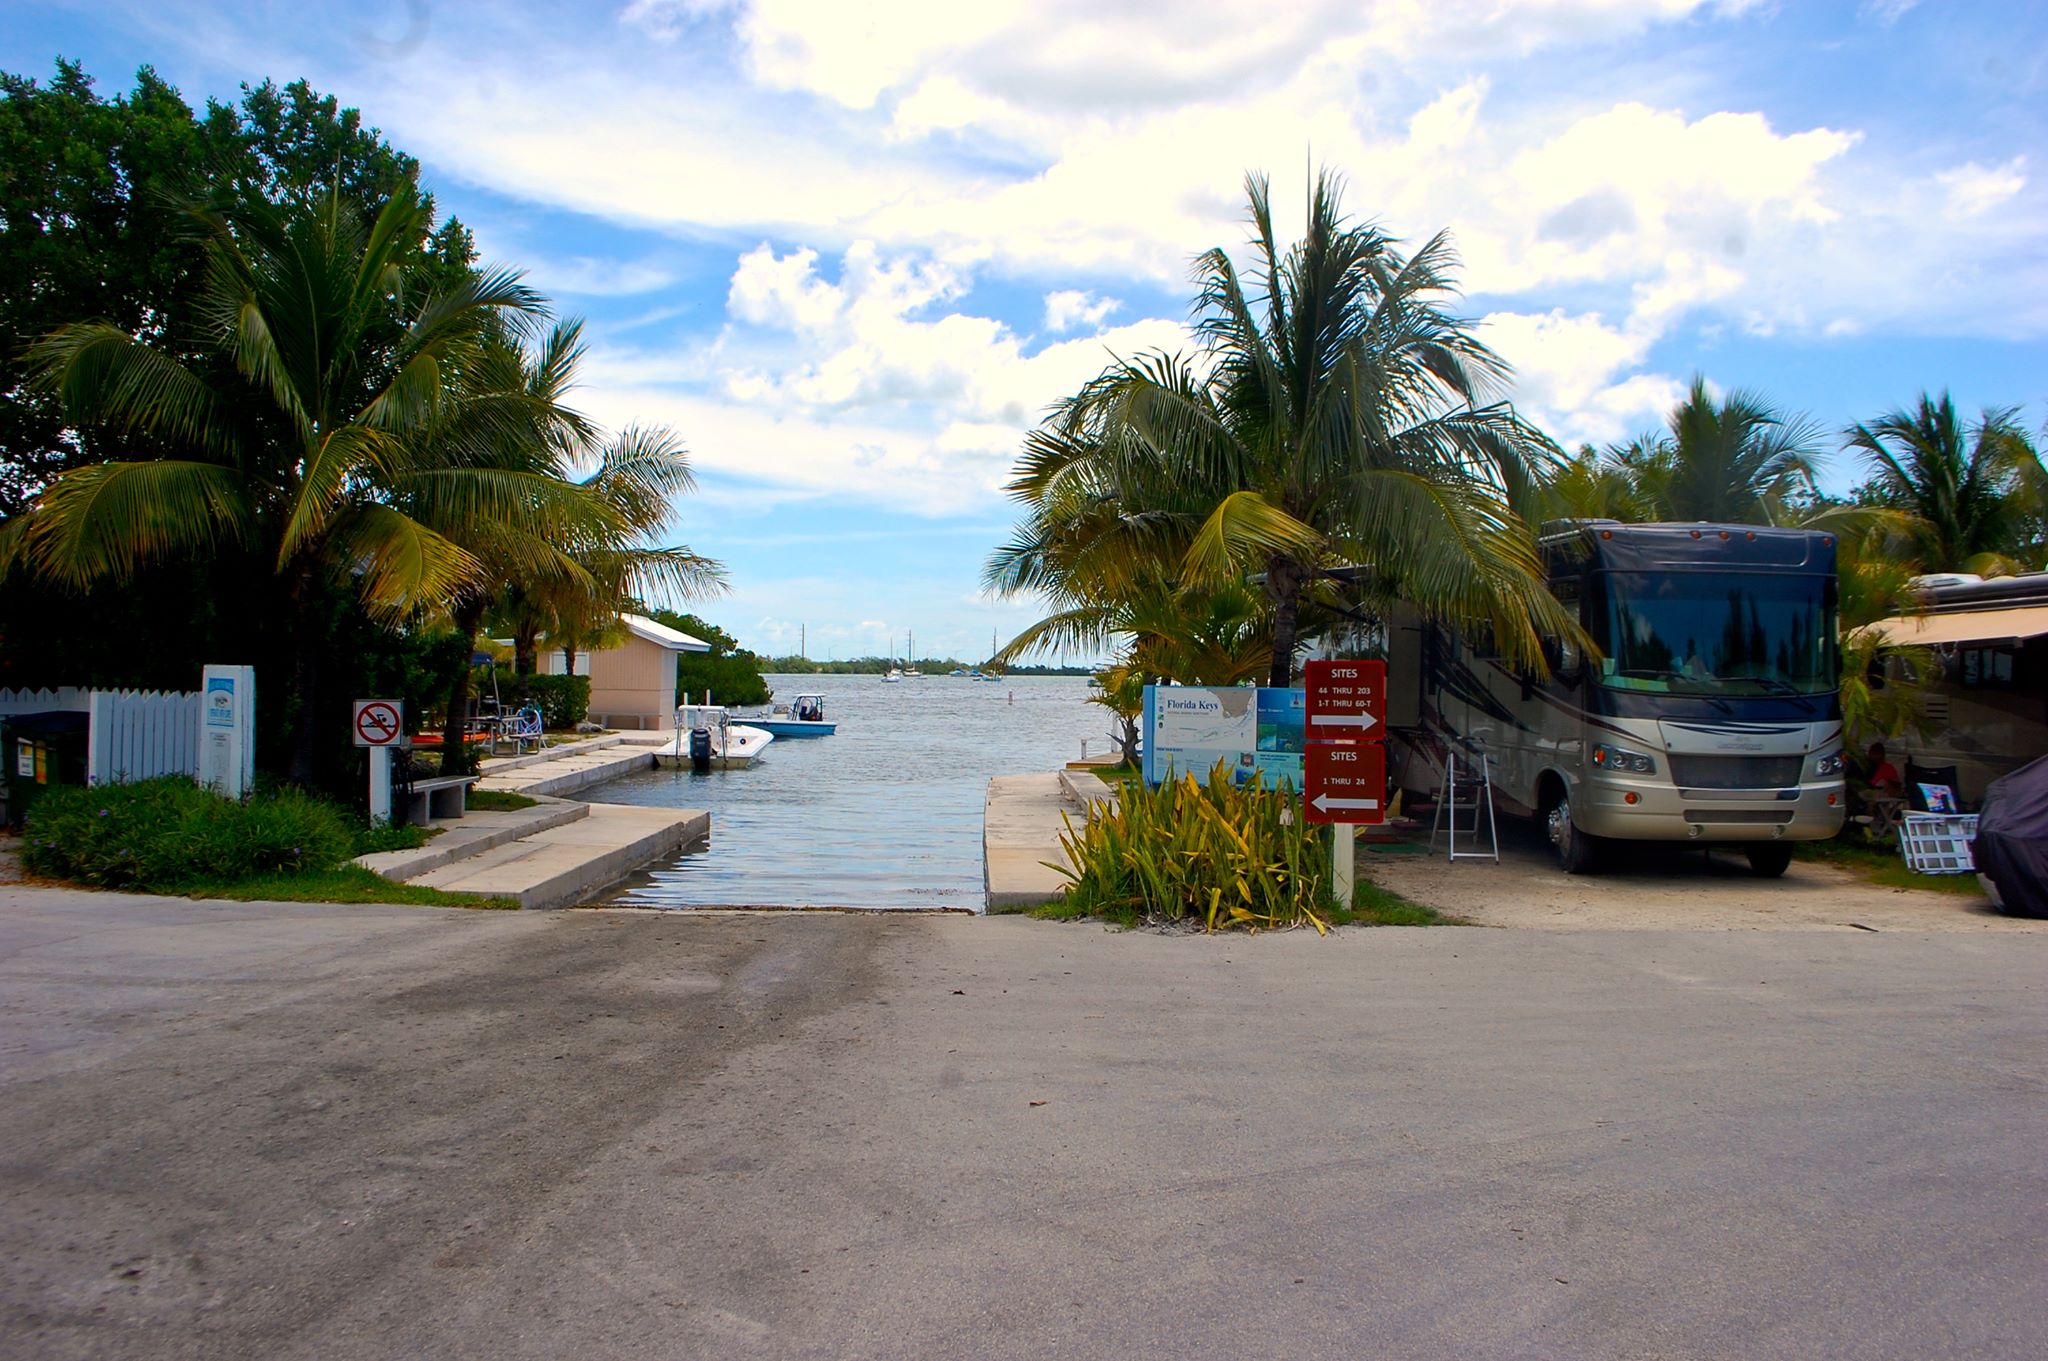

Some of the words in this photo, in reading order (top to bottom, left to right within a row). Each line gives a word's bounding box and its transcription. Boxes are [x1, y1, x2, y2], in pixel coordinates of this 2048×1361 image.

[1331, 668, 1358, 678] SITES
[1167, 699, 1196, 709] Florida
[1199, 700, 1218, 712] Keys
[1331, 751, 1357, 761] SITES
[1323, 777, 1328, 785] 1
[1331, 777, 1351, 785] THRU
[1356, 778, 1365, 786] 24
